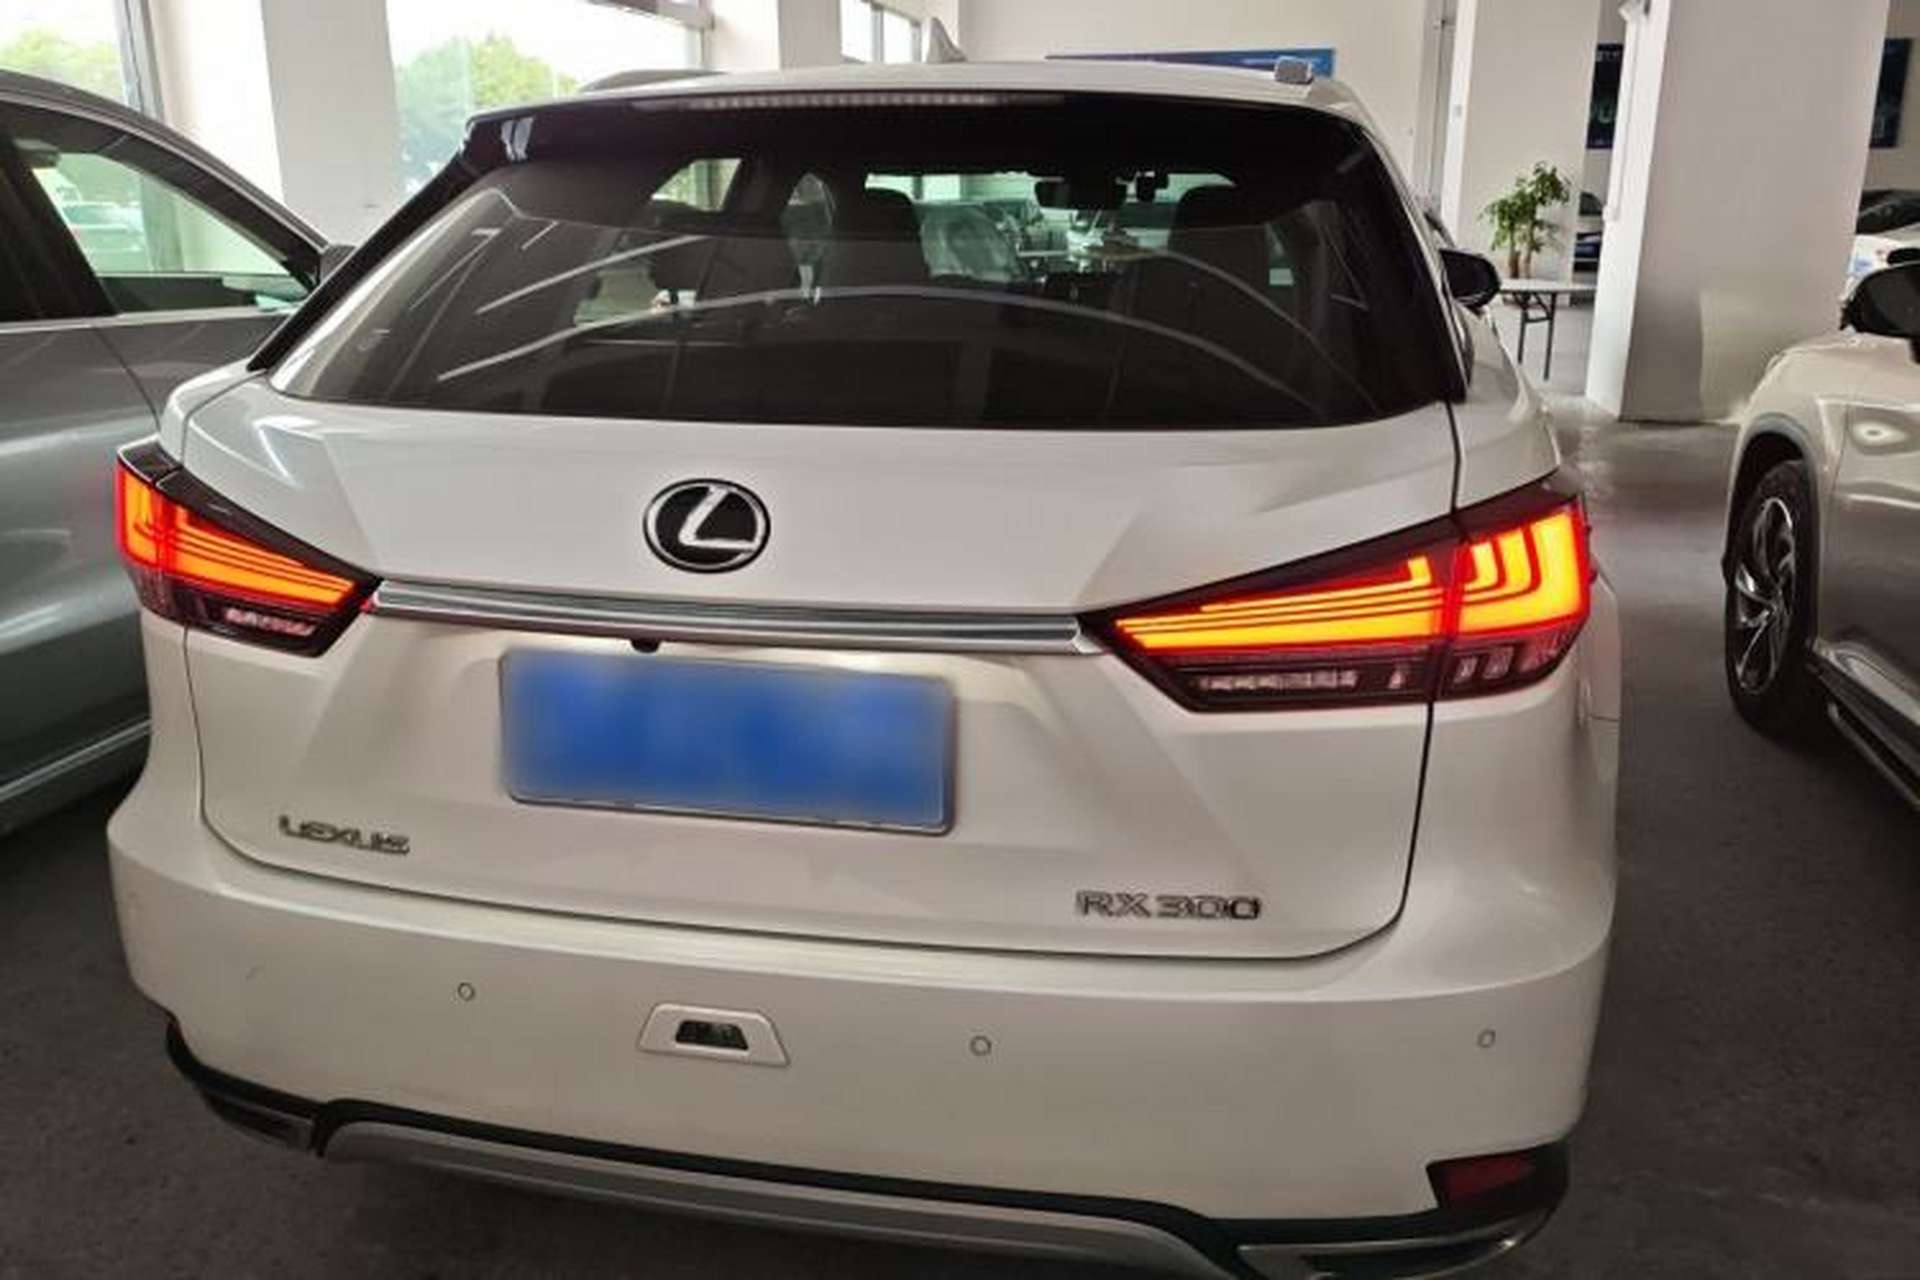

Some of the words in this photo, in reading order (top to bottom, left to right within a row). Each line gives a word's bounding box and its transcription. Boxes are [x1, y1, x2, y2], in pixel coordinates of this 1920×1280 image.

[278, 814, 411, 855] LEXUS
[1075, 890, 1152, 918] RX
[1155, 894, 1262, 921] 300
